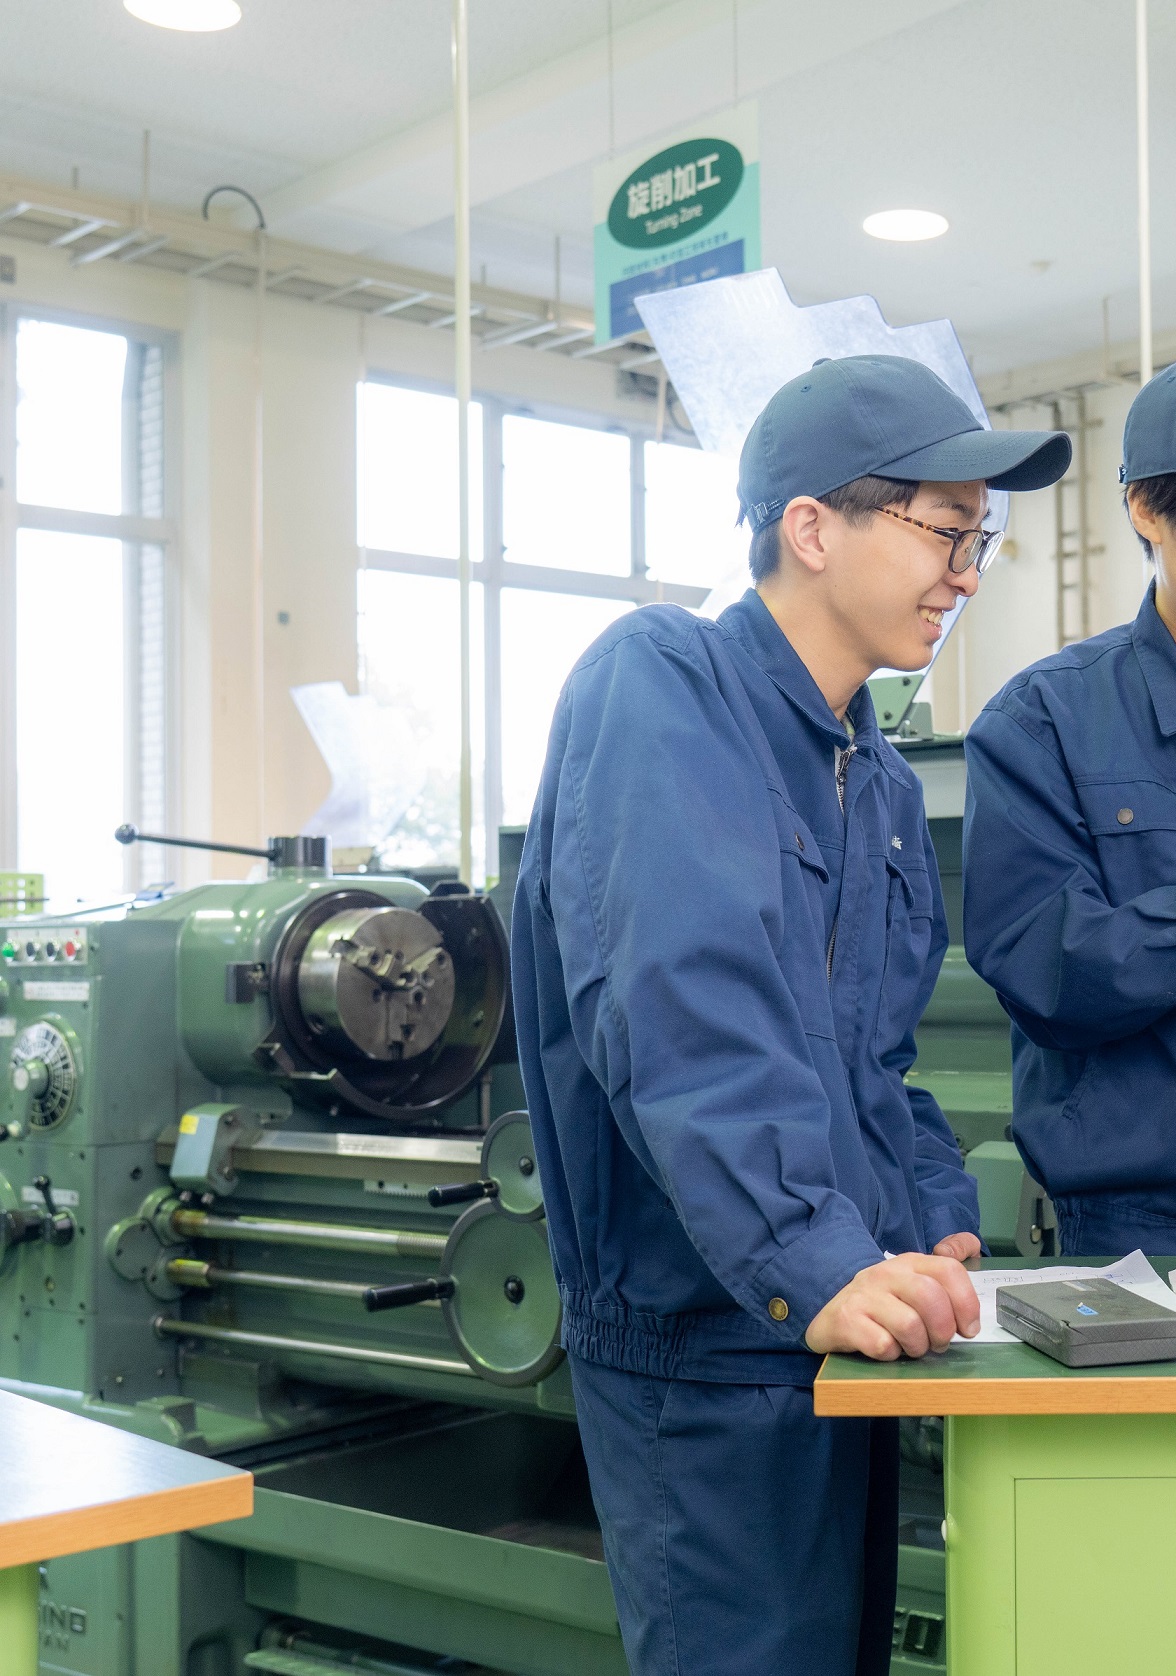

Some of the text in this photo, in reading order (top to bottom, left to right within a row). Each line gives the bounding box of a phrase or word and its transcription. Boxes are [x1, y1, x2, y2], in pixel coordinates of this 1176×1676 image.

[627, 152, 721, 219] 旋削加工
[679, 204, 703, 224] Zone
